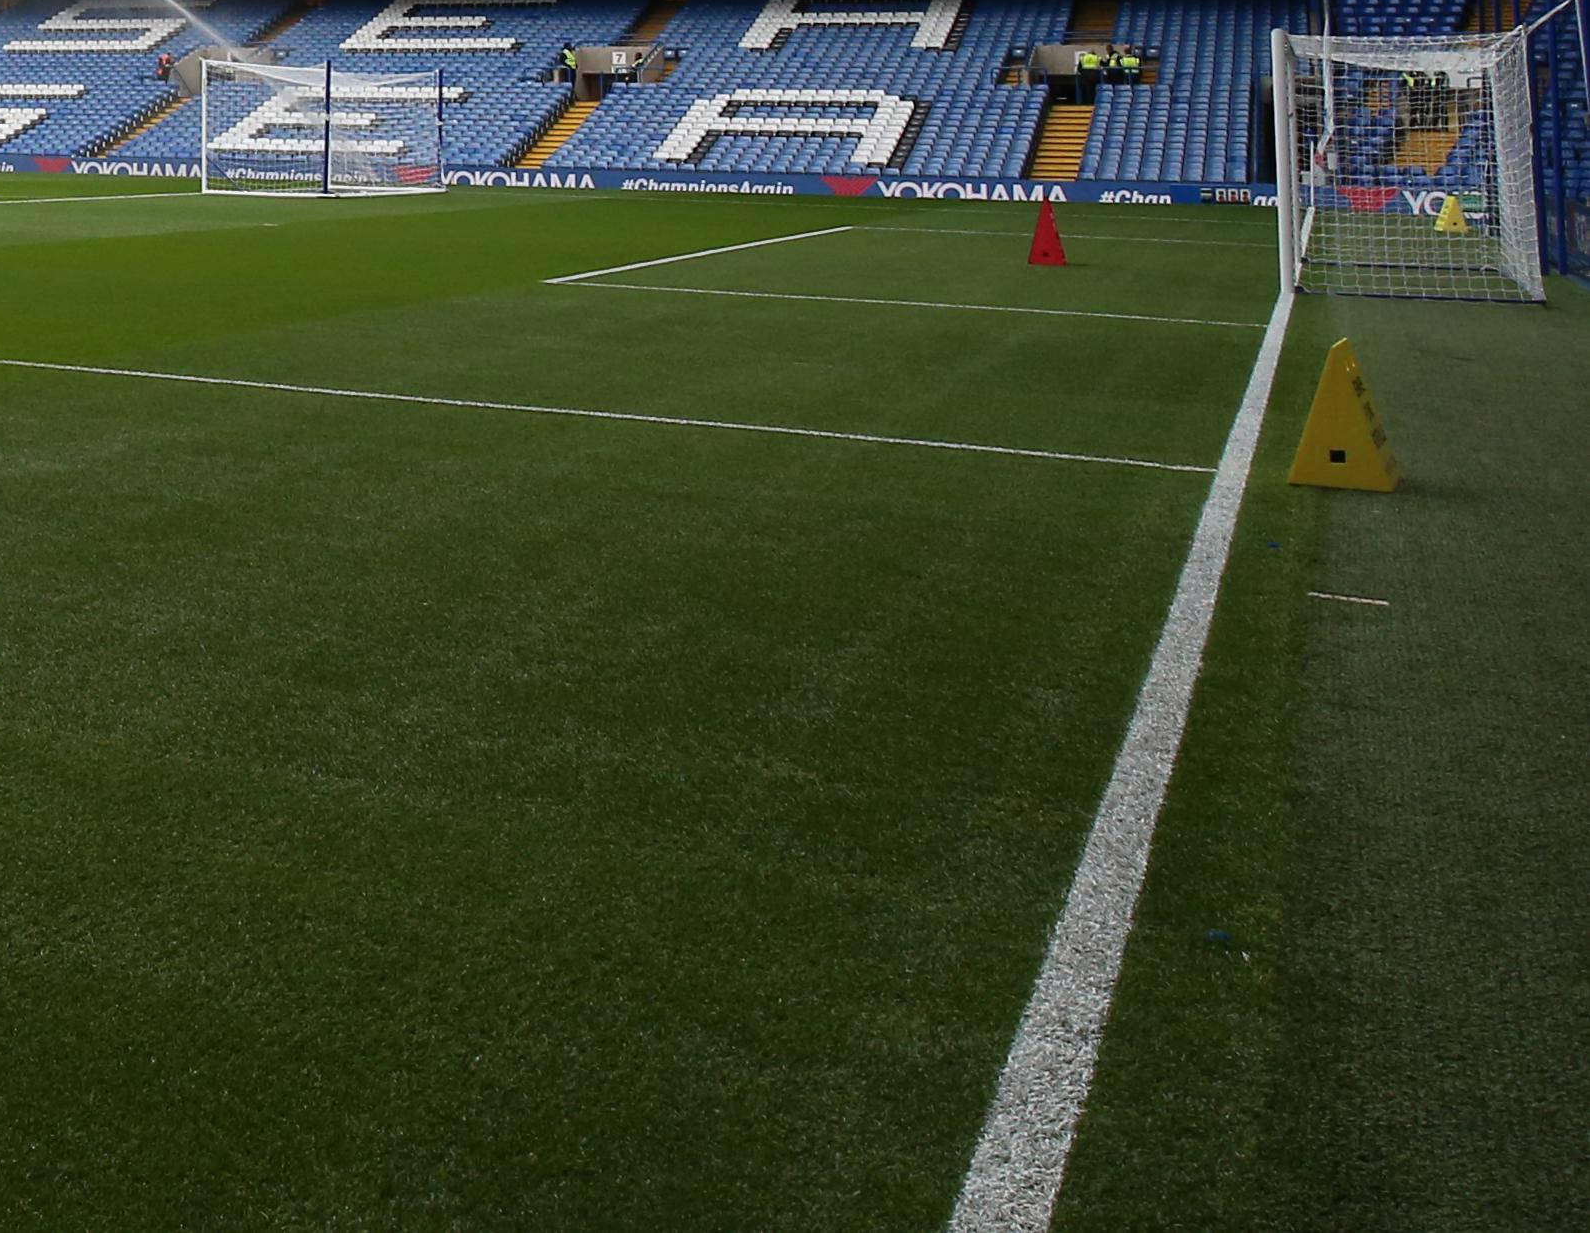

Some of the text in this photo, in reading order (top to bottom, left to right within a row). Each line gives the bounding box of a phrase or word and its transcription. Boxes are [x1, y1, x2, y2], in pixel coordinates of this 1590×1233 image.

[71, 160, 203, 178] YOKOHAMA
[441, 169, 595, 190] YOKOHAMA
[876, 180, 1069, 202] YOKOHAMA
